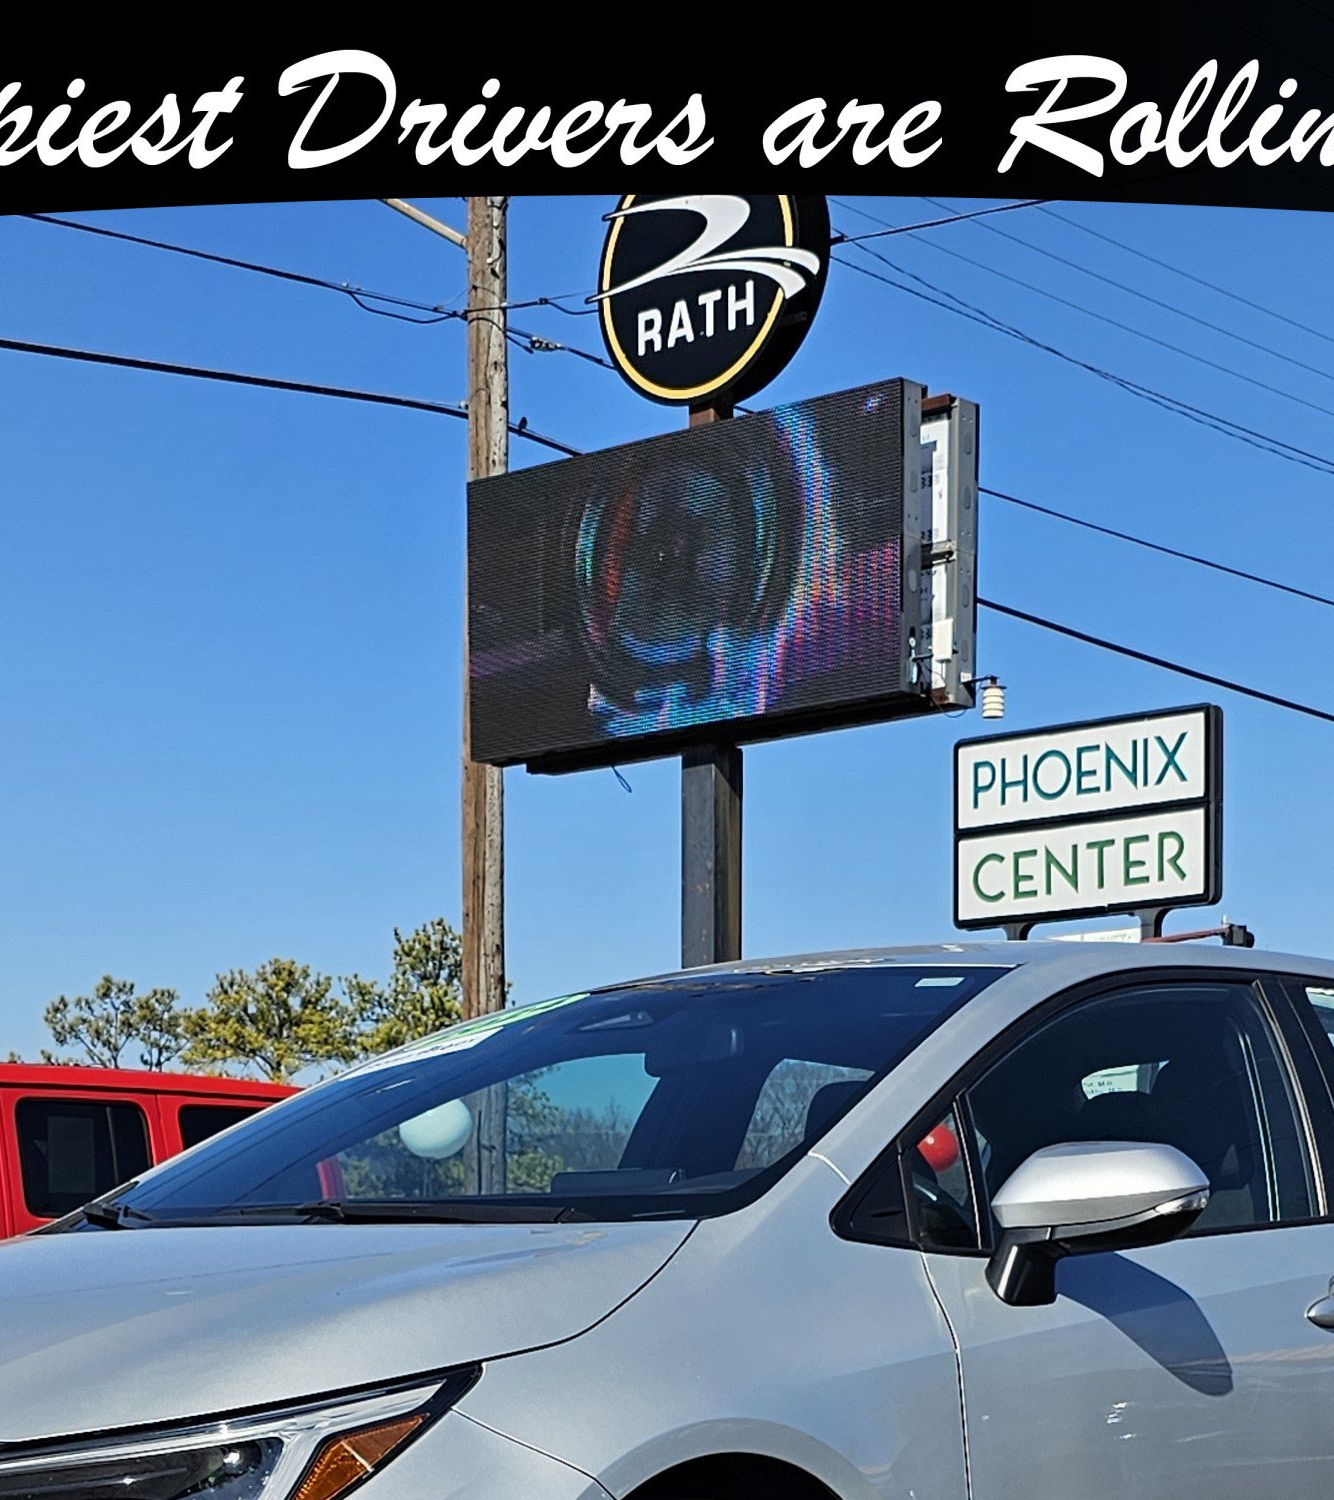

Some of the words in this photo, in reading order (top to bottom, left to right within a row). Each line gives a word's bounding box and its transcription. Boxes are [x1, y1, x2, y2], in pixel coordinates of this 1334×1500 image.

[637, 280, 755, 356] RATH
[972, 731, 1189, 809] PHOENIX
[972, 831, 1188, 903] CENTER
